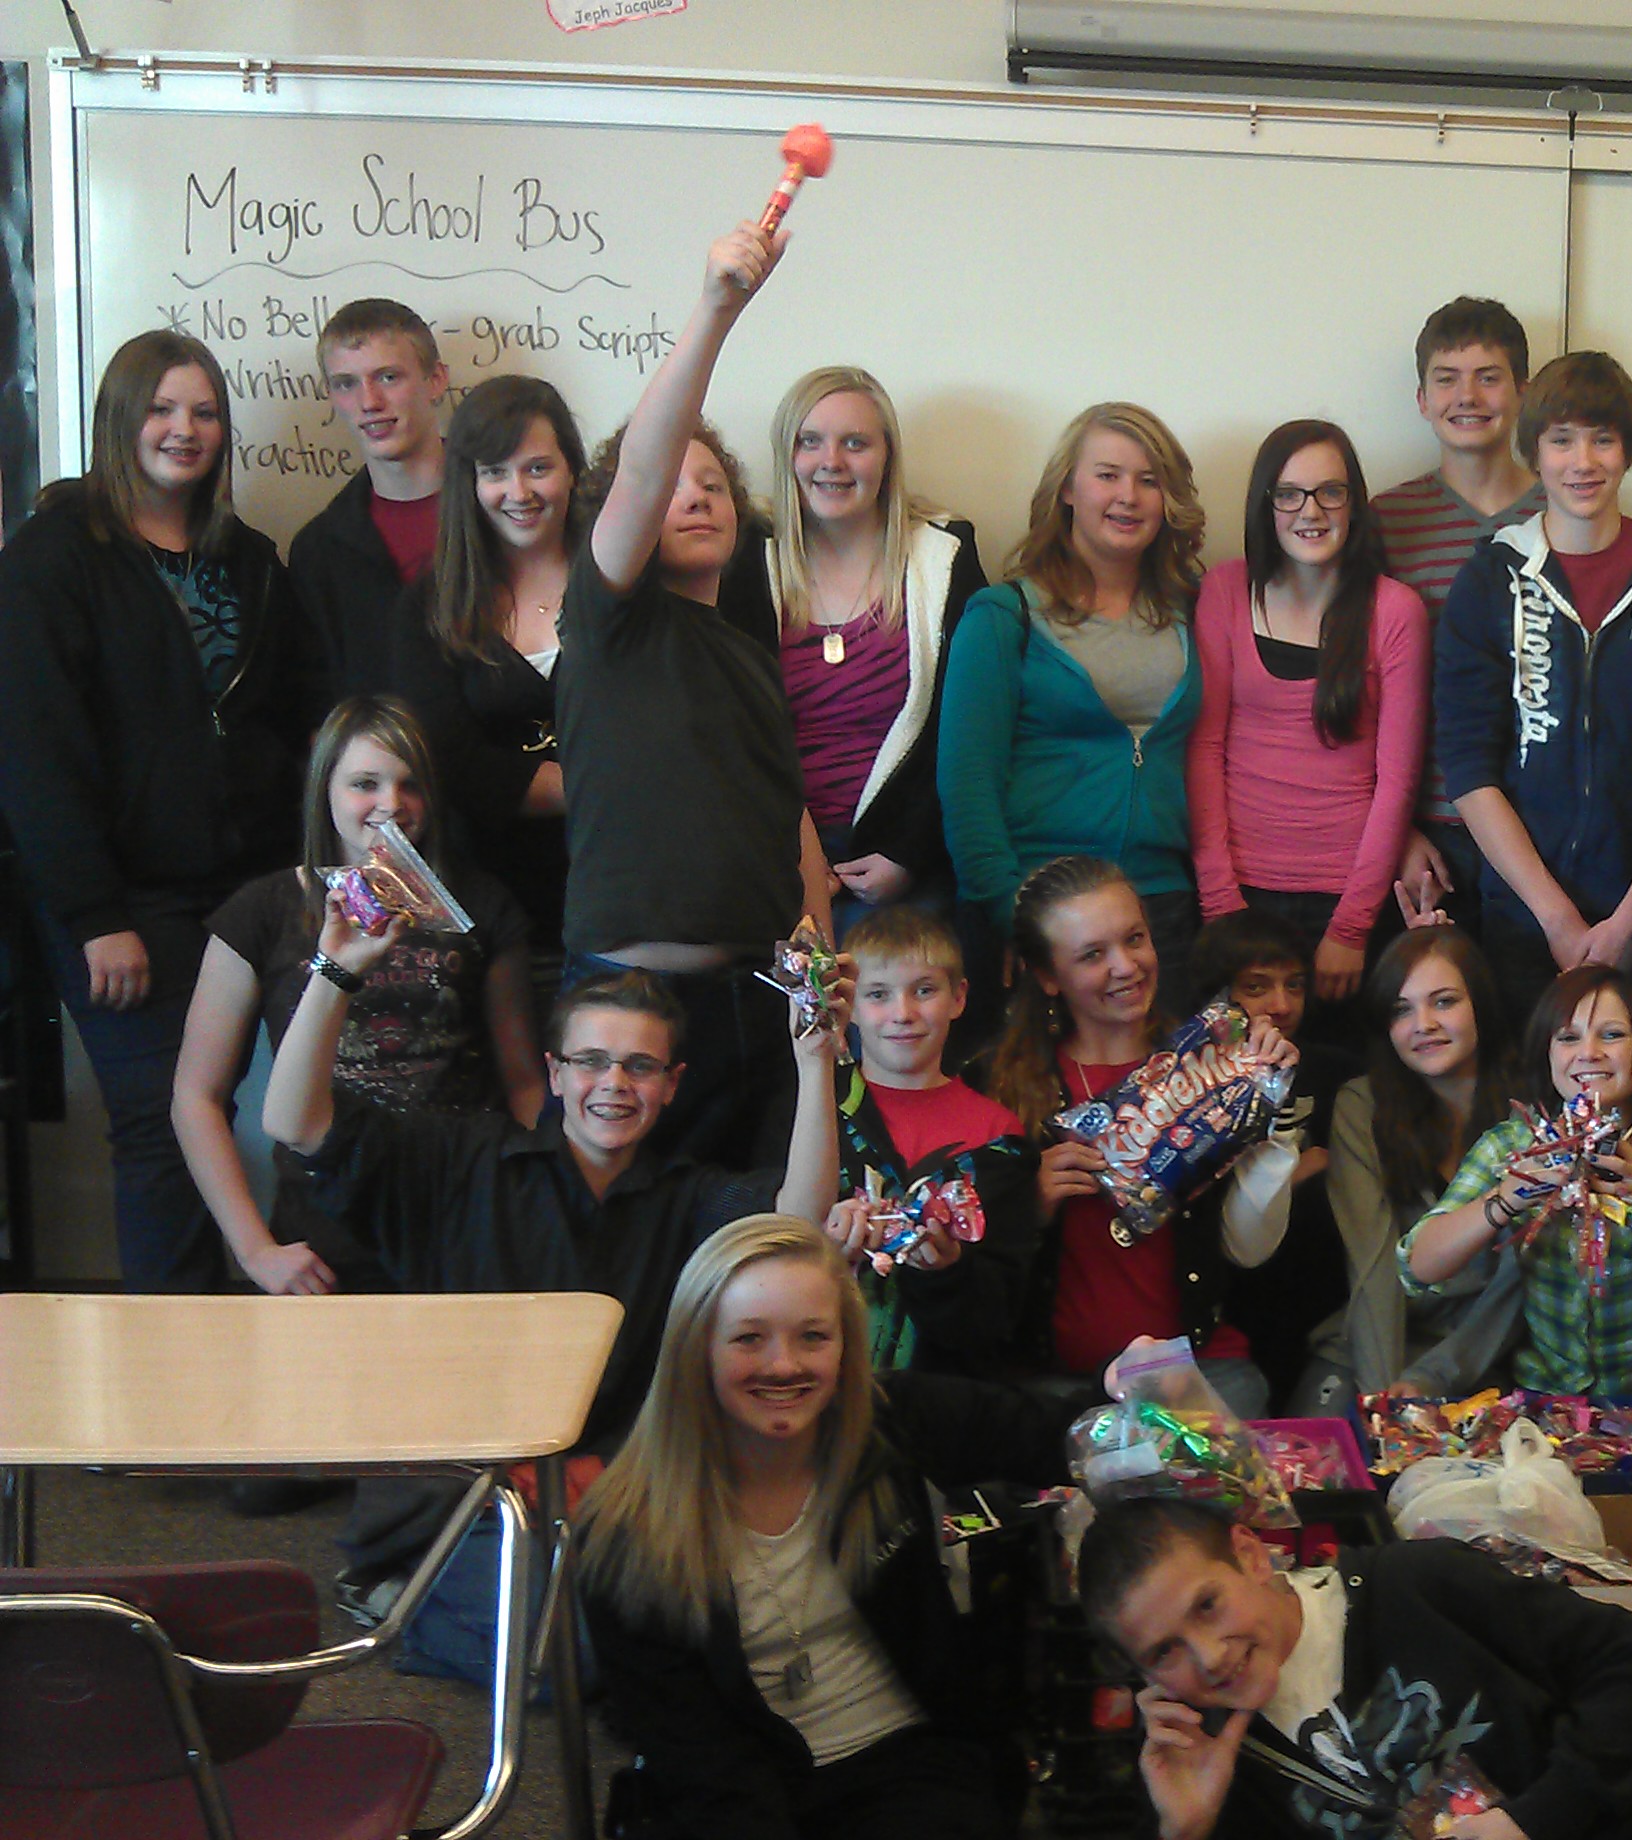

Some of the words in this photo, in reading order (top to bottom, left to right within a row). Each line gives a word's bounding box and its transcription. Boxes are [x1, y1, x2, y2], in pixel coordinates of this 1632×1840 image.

[575, 5, 610, 24] Jeph
[615, 0, 673, 15] Jacques
[184, 165, 324, 265] Magic
[352, 152, 485, 244] School
[512, 177, 606, 256] Bus
[201, 298, 248, 342] No
[470, 308, 561, 367] grab
[577, 311, 677, 375] Scripts
